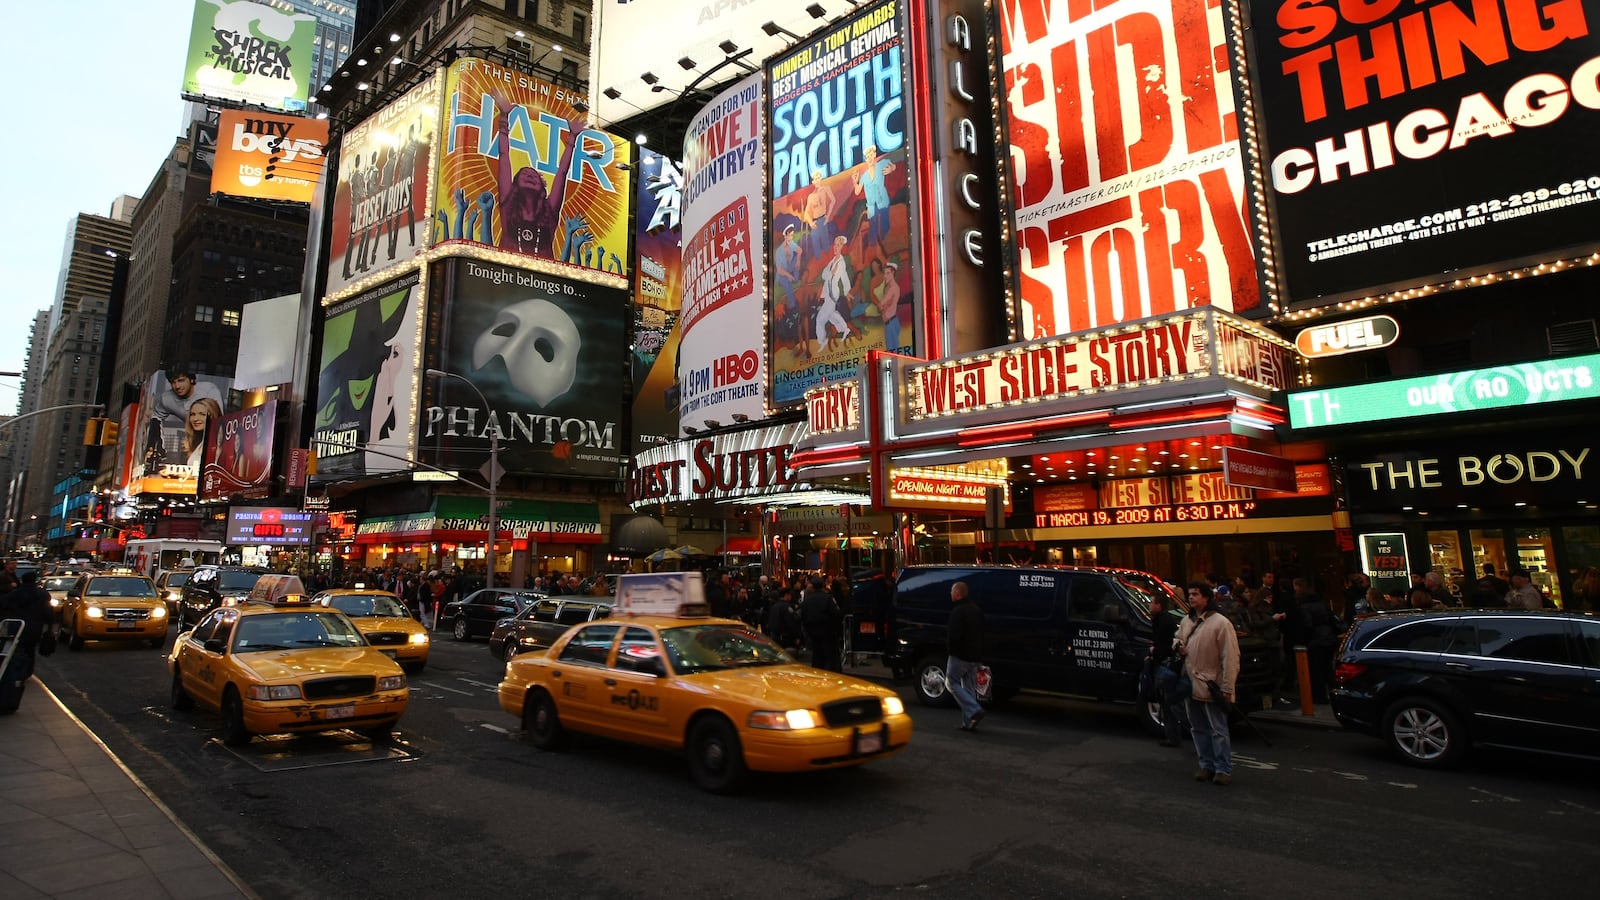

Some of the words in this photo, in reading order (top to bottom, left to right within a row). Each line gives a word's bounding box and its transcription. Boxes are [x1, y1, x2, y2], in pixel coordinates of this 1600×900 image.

[210, 26, 292, 68] SHREK
[772, 47, 812, 81] WINNER!
[815, 42, 822, 59] 7
[824, 25, 851, 53] TONY
[852, 1, 896, 39] AWARDS
[772, 72, 798, 100] BEST
[800, 46, 848, 85] MUSICAL
[850, 19, 898, 59] REVIVAL
[213, 54, 291, 81] MUSICAL
[483, 63, 512, 83] THE
[519, 77, 550, 96] SUN
[773, 82, 812, 108] RODGERS
[822, 37, 900, 83] HAMMERSTEIN'S
[1281, 0, 1589, 123] THING
[711, 105, 721, 122] DO
[723, 94, 739, 116] FOR
[740, 83, 758, 106] YOU
[773, 45, 902, 151] SOUTH
[1002, 0, 1240, 208] SIDE
[231, 123, 323, 163] boys
[244, 118, 295, 148] my
[343, 117, 376, 148] BEST
[446, 88, 616, 193] HAIR
[695, 108, 742, 173] HAVE
[1457, 128, 1478, 138] THE
[1482, 112, 1535, 131] MUSICAL
[773, 96, 904, 200] PACIFIC
[239, 164, 263, 177] tbs
[285, 175, 311, 187] funny
[690, 138, 758, 204] COUNTRY?
[1017, 180, 1133, 225] TICKETMASTER.COM
[1145, 147, 1236, 183] 212-307-4100
[351, 189, 387, 234] JERSEY
[387, 176, 412, 217] BOYS
[703, 204, 745, 245] EVENT
[1307, 208, 1463, 253] TELECHARGE.COM
[1318, 242, 1369, 261] AMBASSADOR
[1369, 234, 1404, 250] THEATRE
[1408, 228, 1431, 241] 49TH
[1431, 225, 1446, 236] ST.
[1446, 222, 1458, 233] AT
[1458, 215, 1487, 230] B'WAY
[1016, 168, 1262, 340] STORY
[466, 262, 514, 285] Tonight
[516, 271, 561, 295] belongs
[562, 283, 587, 298] to...
[696, 249, 748, 302] AMERICA
[827, 353, 835, 361] BY
[836, 345, 867, 358] BARTLETT
[867, 341, 883, 351] SHER
[1309, 319, 1384, 353] FUEL
[713, 349, 759, 389] HBO
[775, 368, 818, 385] LINCOLN
[818, 357, 860, 377] CENTER
[789, 382, 806, 391] TAKE
[920, 360, 994, 417] WEST
[999, 345, 1080, 403] SIDE
[1088, 320, 1194, 388] STORY
[701, 394, 710, 408] THE
[711, 390, 727, 405] CORT
[728, 383, 759, 401] THEATRE
[225, 419, 239, 440] go
[242, 408, 260, 430] red
[424, 404, 616, 451] PHANTOM
[640, 434, 656, 443] TEXT
[897, 479, 934, 494] OPENING
[935, 483, 963, 496] NIGHT:
[1360, 458, 1443, 491] THE
[1458, 447, 1591, 487] BODY
[1100, 478, 1145, 509] WEST
[1147, 475, 1195, 506] SIDE
[254, 524, 284, 536] GIFTS
[441, 517, 490, 531] sbarro
[500, 518, 545, 532] sbarro
[555, 521, 597, 533] sbarro
[803, 508, 824, 518] STAGE
[1050, 511, 1089, 527] MARCH
[1092, 511, 1112, 525] 19,
[1116, 508, 1150, 524] 2009
[1154, 507, 1172, 522] AT
[1176, 505, 1209, 521] 6:30
[1377, 546, 1392, 554] YES
[1089, 630, 1109, 639] RENTALS
[1100, 641, 1115, 649] SOUTH
